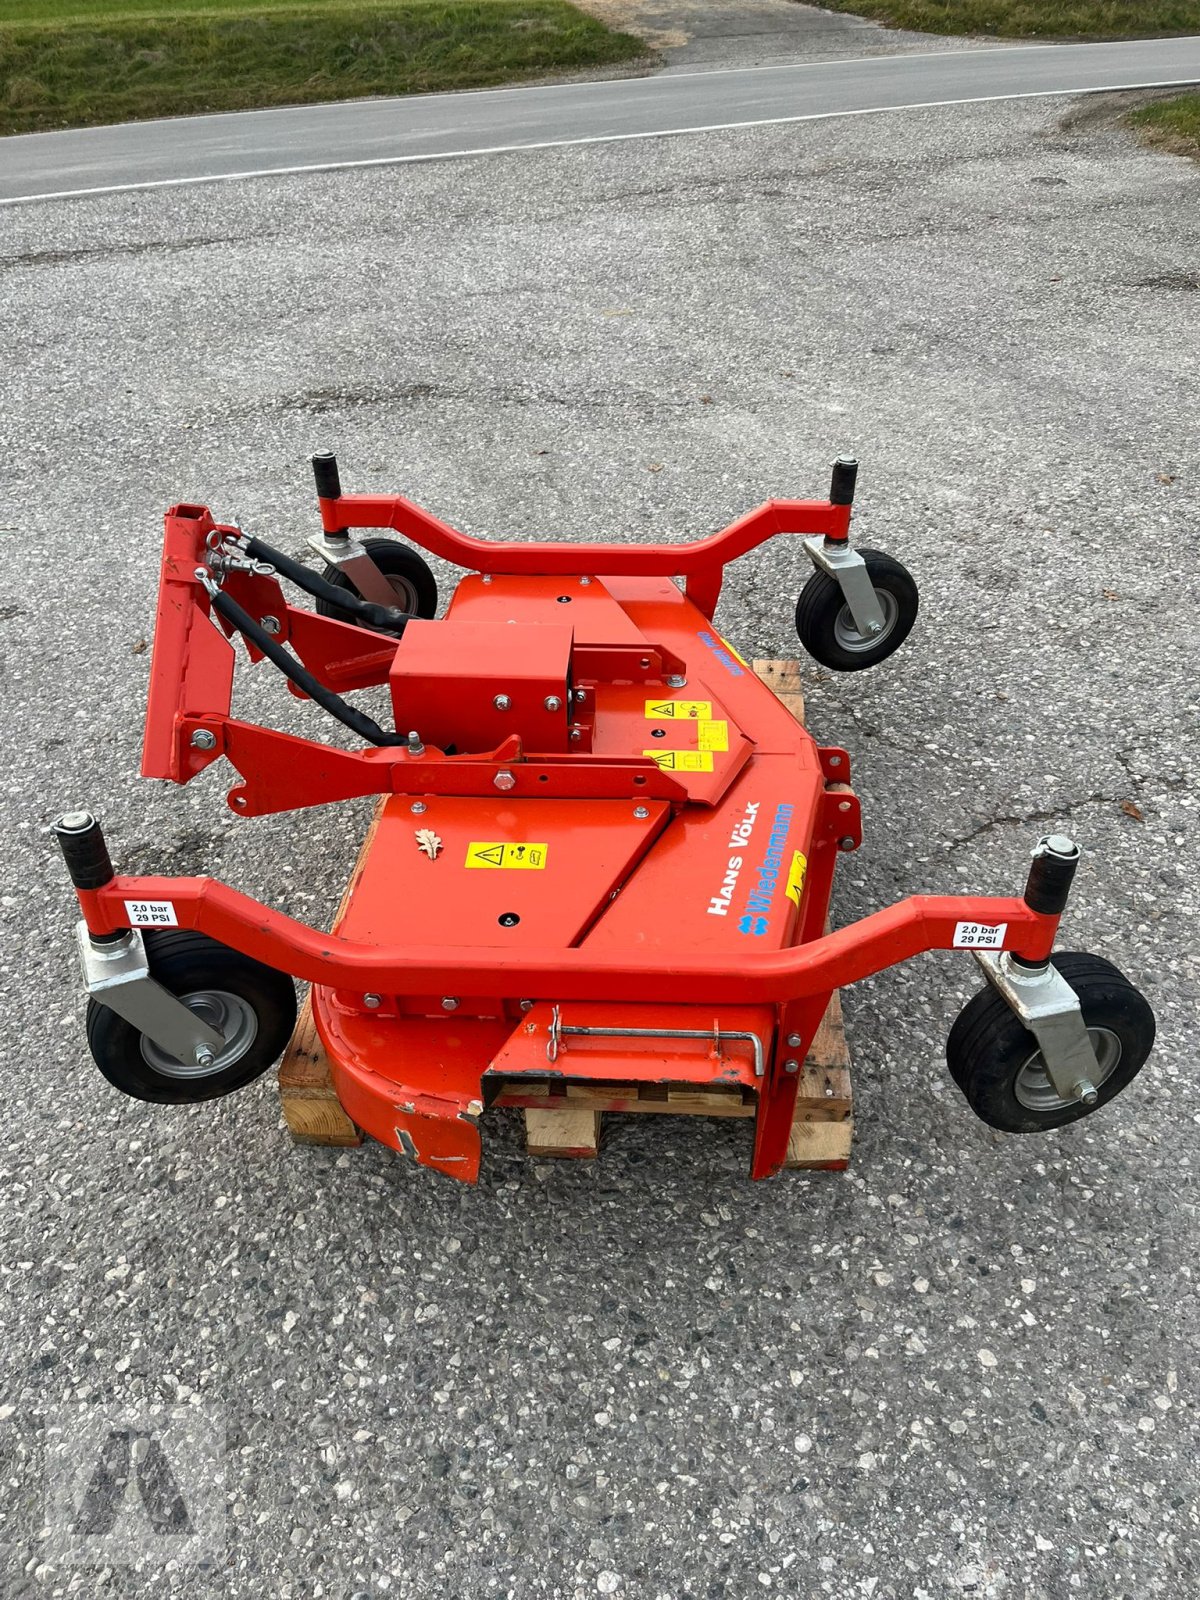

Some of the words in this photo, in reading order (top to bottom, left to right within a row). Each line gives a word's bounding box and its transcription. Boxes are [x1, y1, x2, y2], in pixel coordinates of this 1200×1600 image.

[706, 855, 743, 916] HANS
[727, 801, 760, 849] VÖLK
[744, 803, 795, 913] Wiedenmann
[132, 904, 148, 913] 2,0
[149, 904, 168, 913] bar
[136, 914, 149, 922] 29
[151, 914, 171, 922] PSI
[961, 925, 978, 935] 2,0
[980, 926, 1001, 935] bar
[960, 935, 975, 943] 29
[977, 936, 997, 944] PSI
